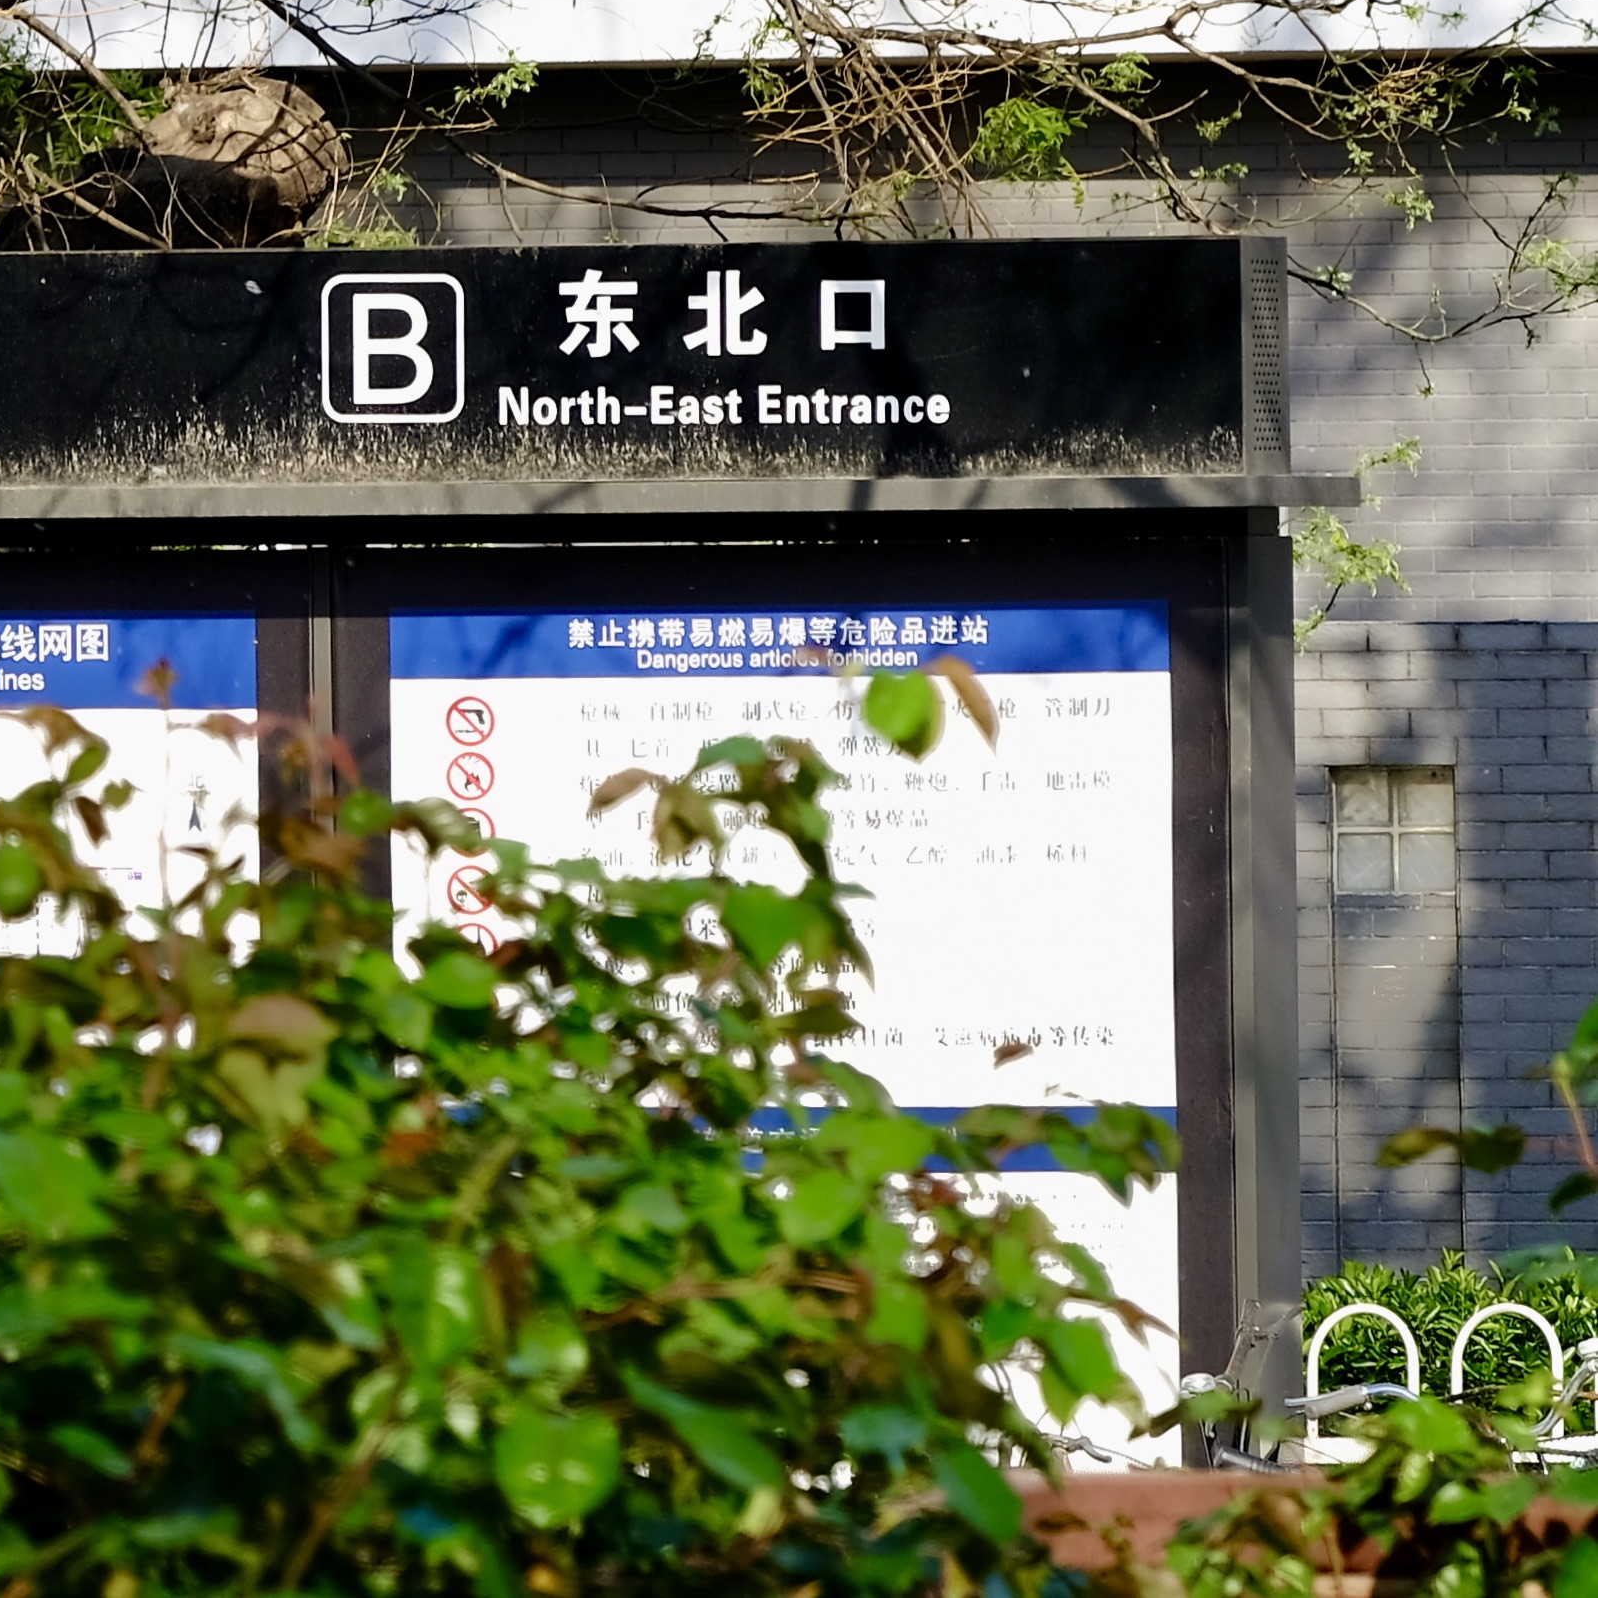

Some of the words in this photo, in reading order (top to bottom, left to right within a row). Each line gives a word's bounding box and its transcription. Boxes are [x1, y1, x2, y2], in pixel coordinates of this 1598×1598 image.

[558, 268, 887, 359] 东北口
[352, 292, 434, 406] B
[498, 385, 743, 427] North-East
[758, 384, 952, 425] Entrance
[568, 614, 989, 650] 禁止携带易燃易爆等危险品进站
[636, 649, 745, 673] Dangerous
[825, 647, 919, 668] forbidden
